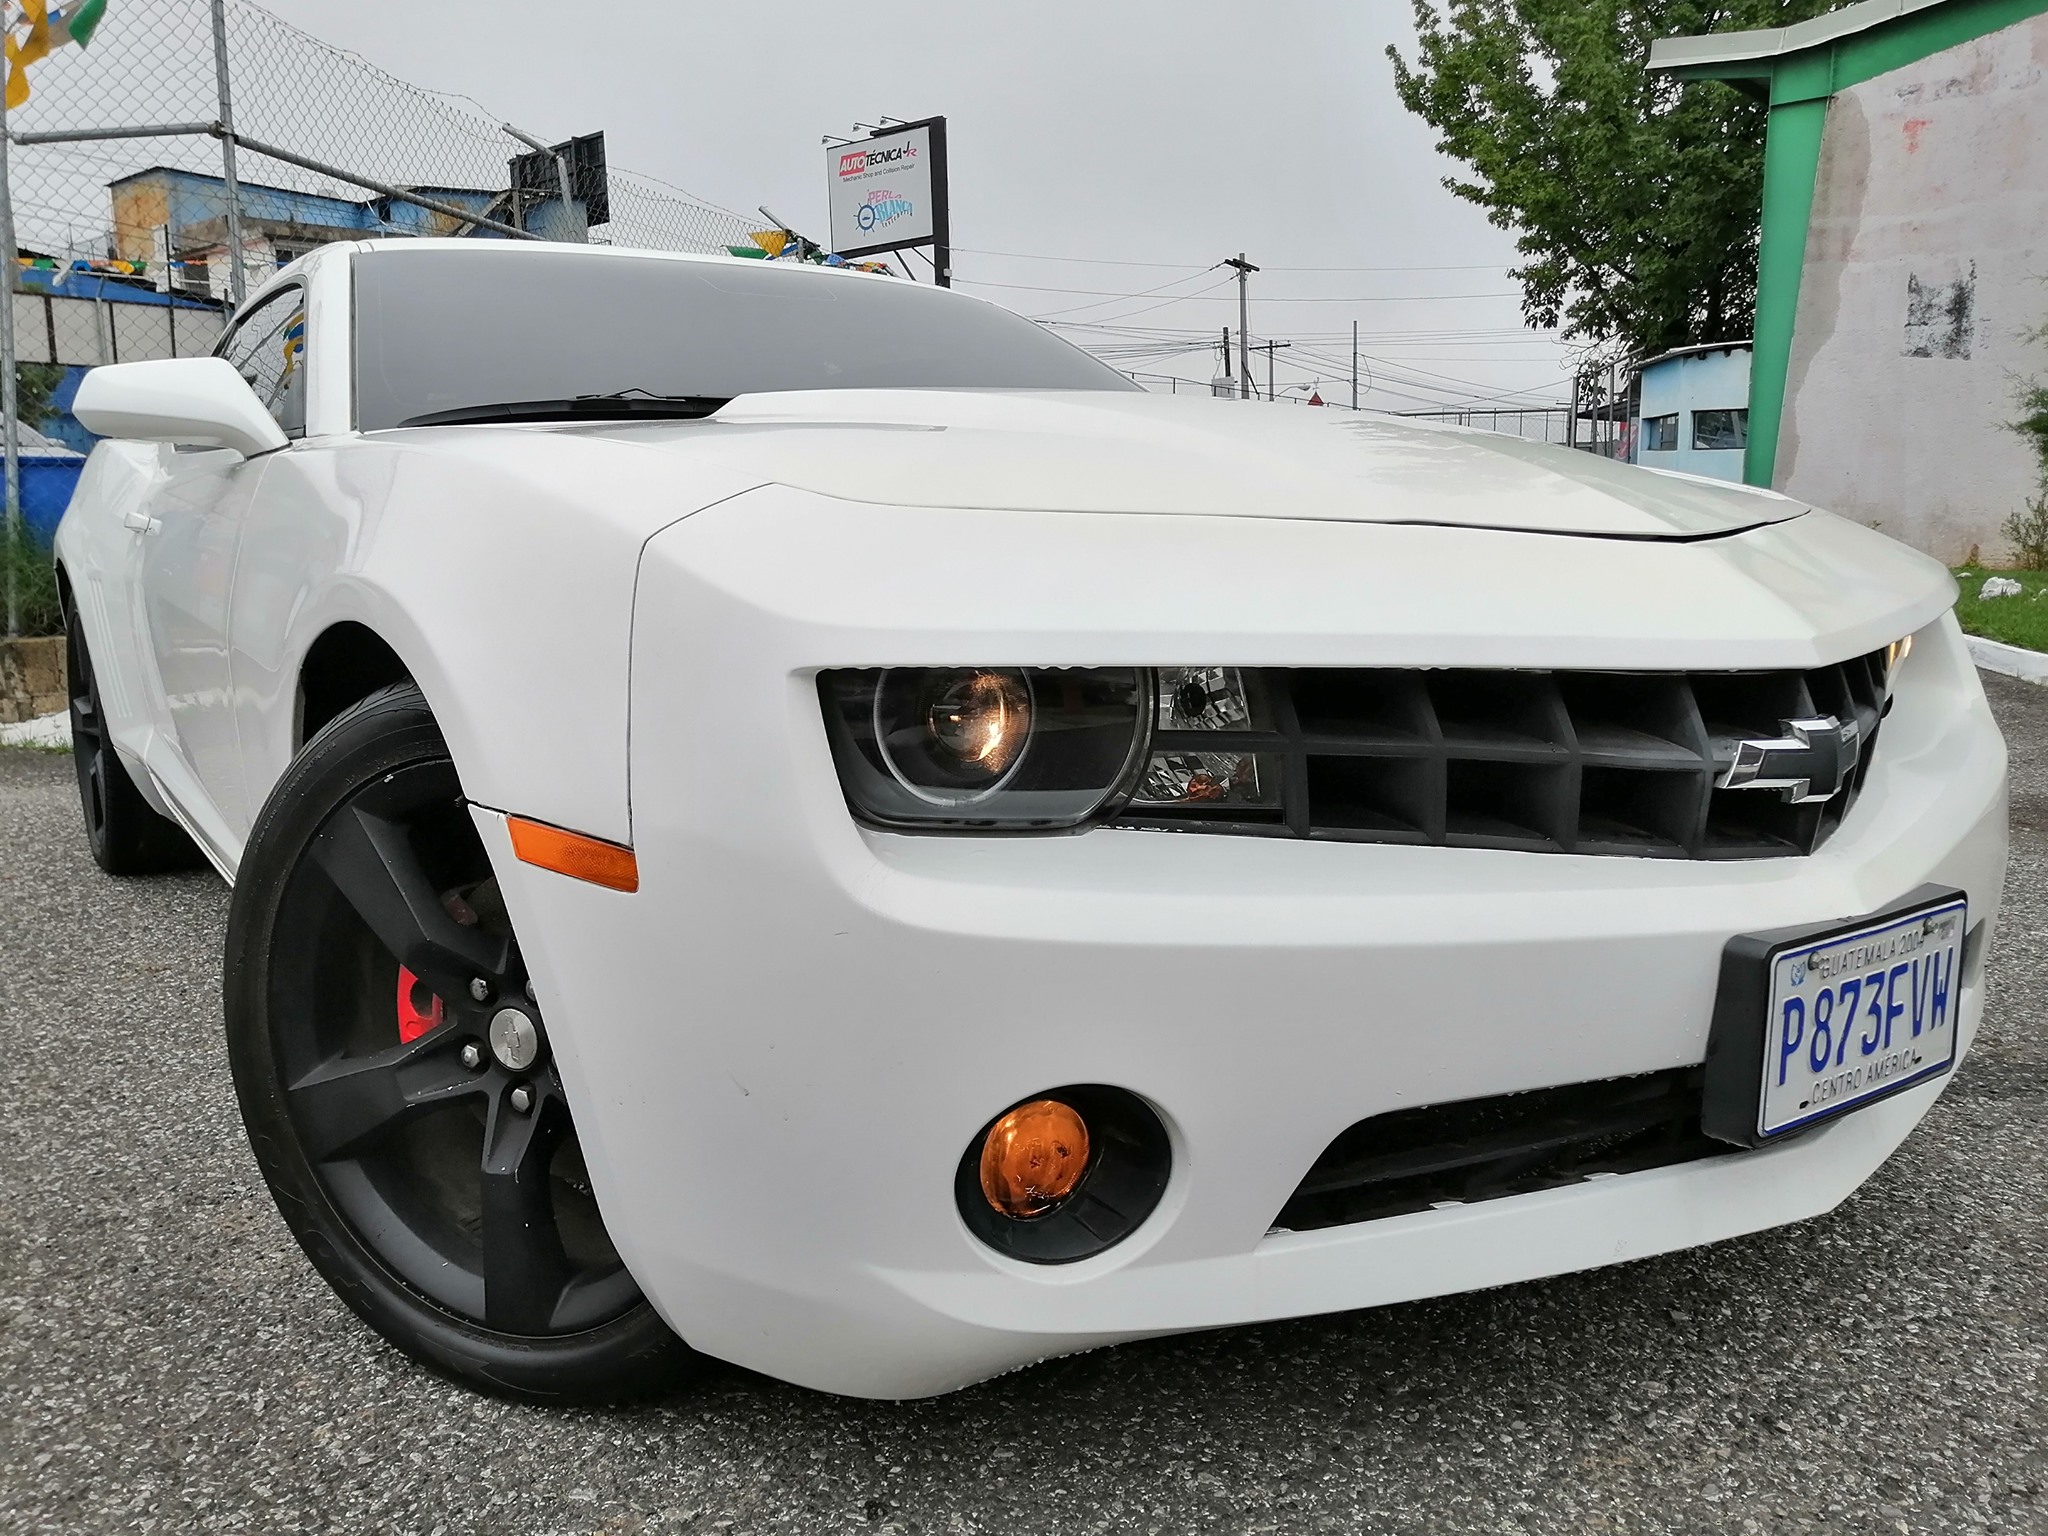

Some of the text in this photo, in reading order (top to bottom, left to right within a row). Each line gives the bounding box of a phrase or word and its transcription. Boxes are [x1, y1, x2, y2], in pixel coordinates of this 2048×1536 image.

[842, 163, 915, 183] Mechanic Shop and Collision Repair
[1820, 937, 1896, 979] GUATEMALA
[1777, 945, 1955, 1087] P873FVW
[1812, 1045, 1917, 1106] CENTRO AMÉRICA
